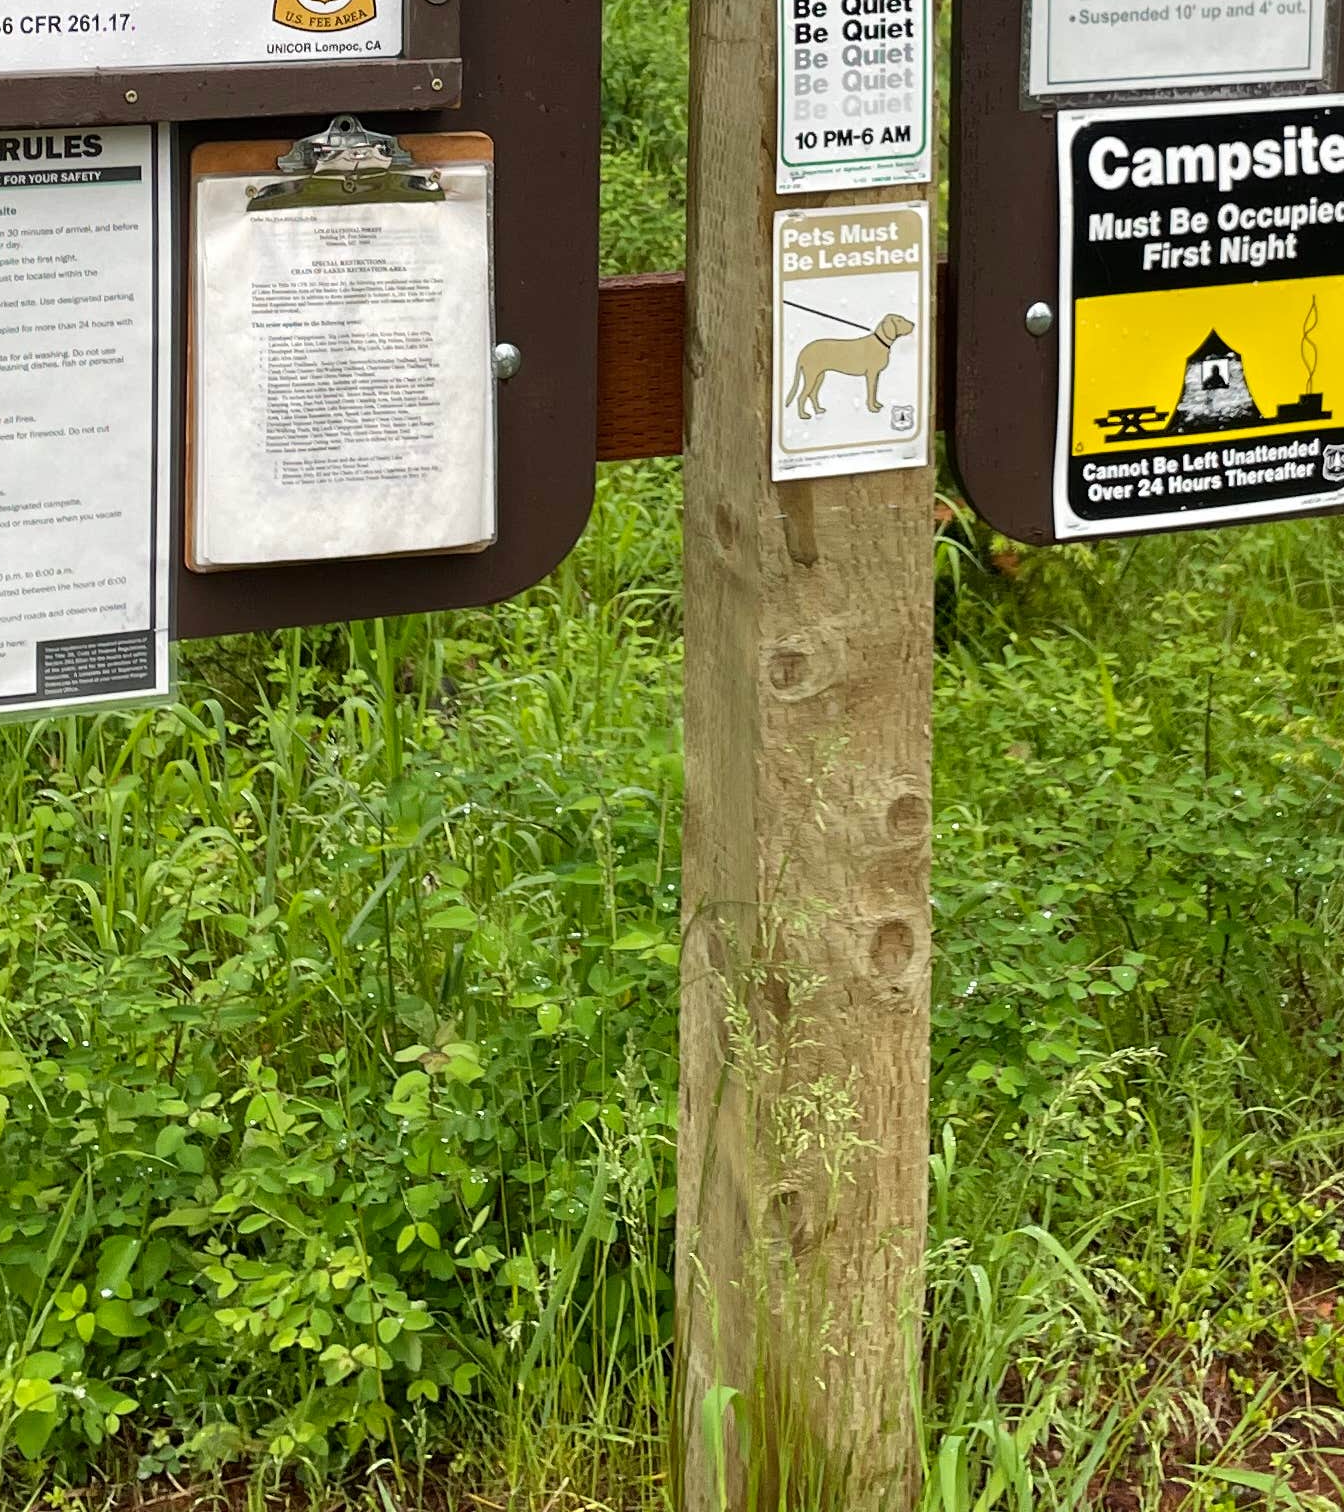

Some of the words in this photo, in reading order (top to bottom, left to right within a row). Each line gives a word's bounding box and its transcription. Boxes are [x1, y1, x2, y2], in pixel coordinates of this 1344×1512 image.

[21, 16, 61, 33] CFR
[68, 14, 135, 32] 261.17.
[267, 43, 311, 54] UNICOR
[366, 41, 381, 50] CA
[0, 134, 102, 161] RULES
[796, 132, 817, 149] 10
[824, 128, 873, 147] PM-6
[881, 126, 910, 143] AM
[4, 175, 26, 185] FOR
[29, 173, 58, 183] YOUR
[61, 171, 101, 182] SAFETY
[783, 228, 834, 248] Pets
[841, 222, 898, 243] Must
[1089, 211, 1161, 241] Must
[1170, 208, 1208, 234] Be
[784, 253, 813, 272] Be
[819, 244, 919, 269] Leashed
[1143, 240, 1211, 270] First
[1220, 233, 1297, 266] Night
[1083, 459, 1149, 481] Cannot
[1153, 457, 1178, 474] Be
[1183, 452, 1219, 471] Left
[1223, 438, 1319, 467] Unattended
[1088, 484, 1133, 501] Over
[1138, 478, 1163, 496] 24
[1169, 475, 1222, 493] Hours
[1225, 462, 1314, 486] Thereafter
